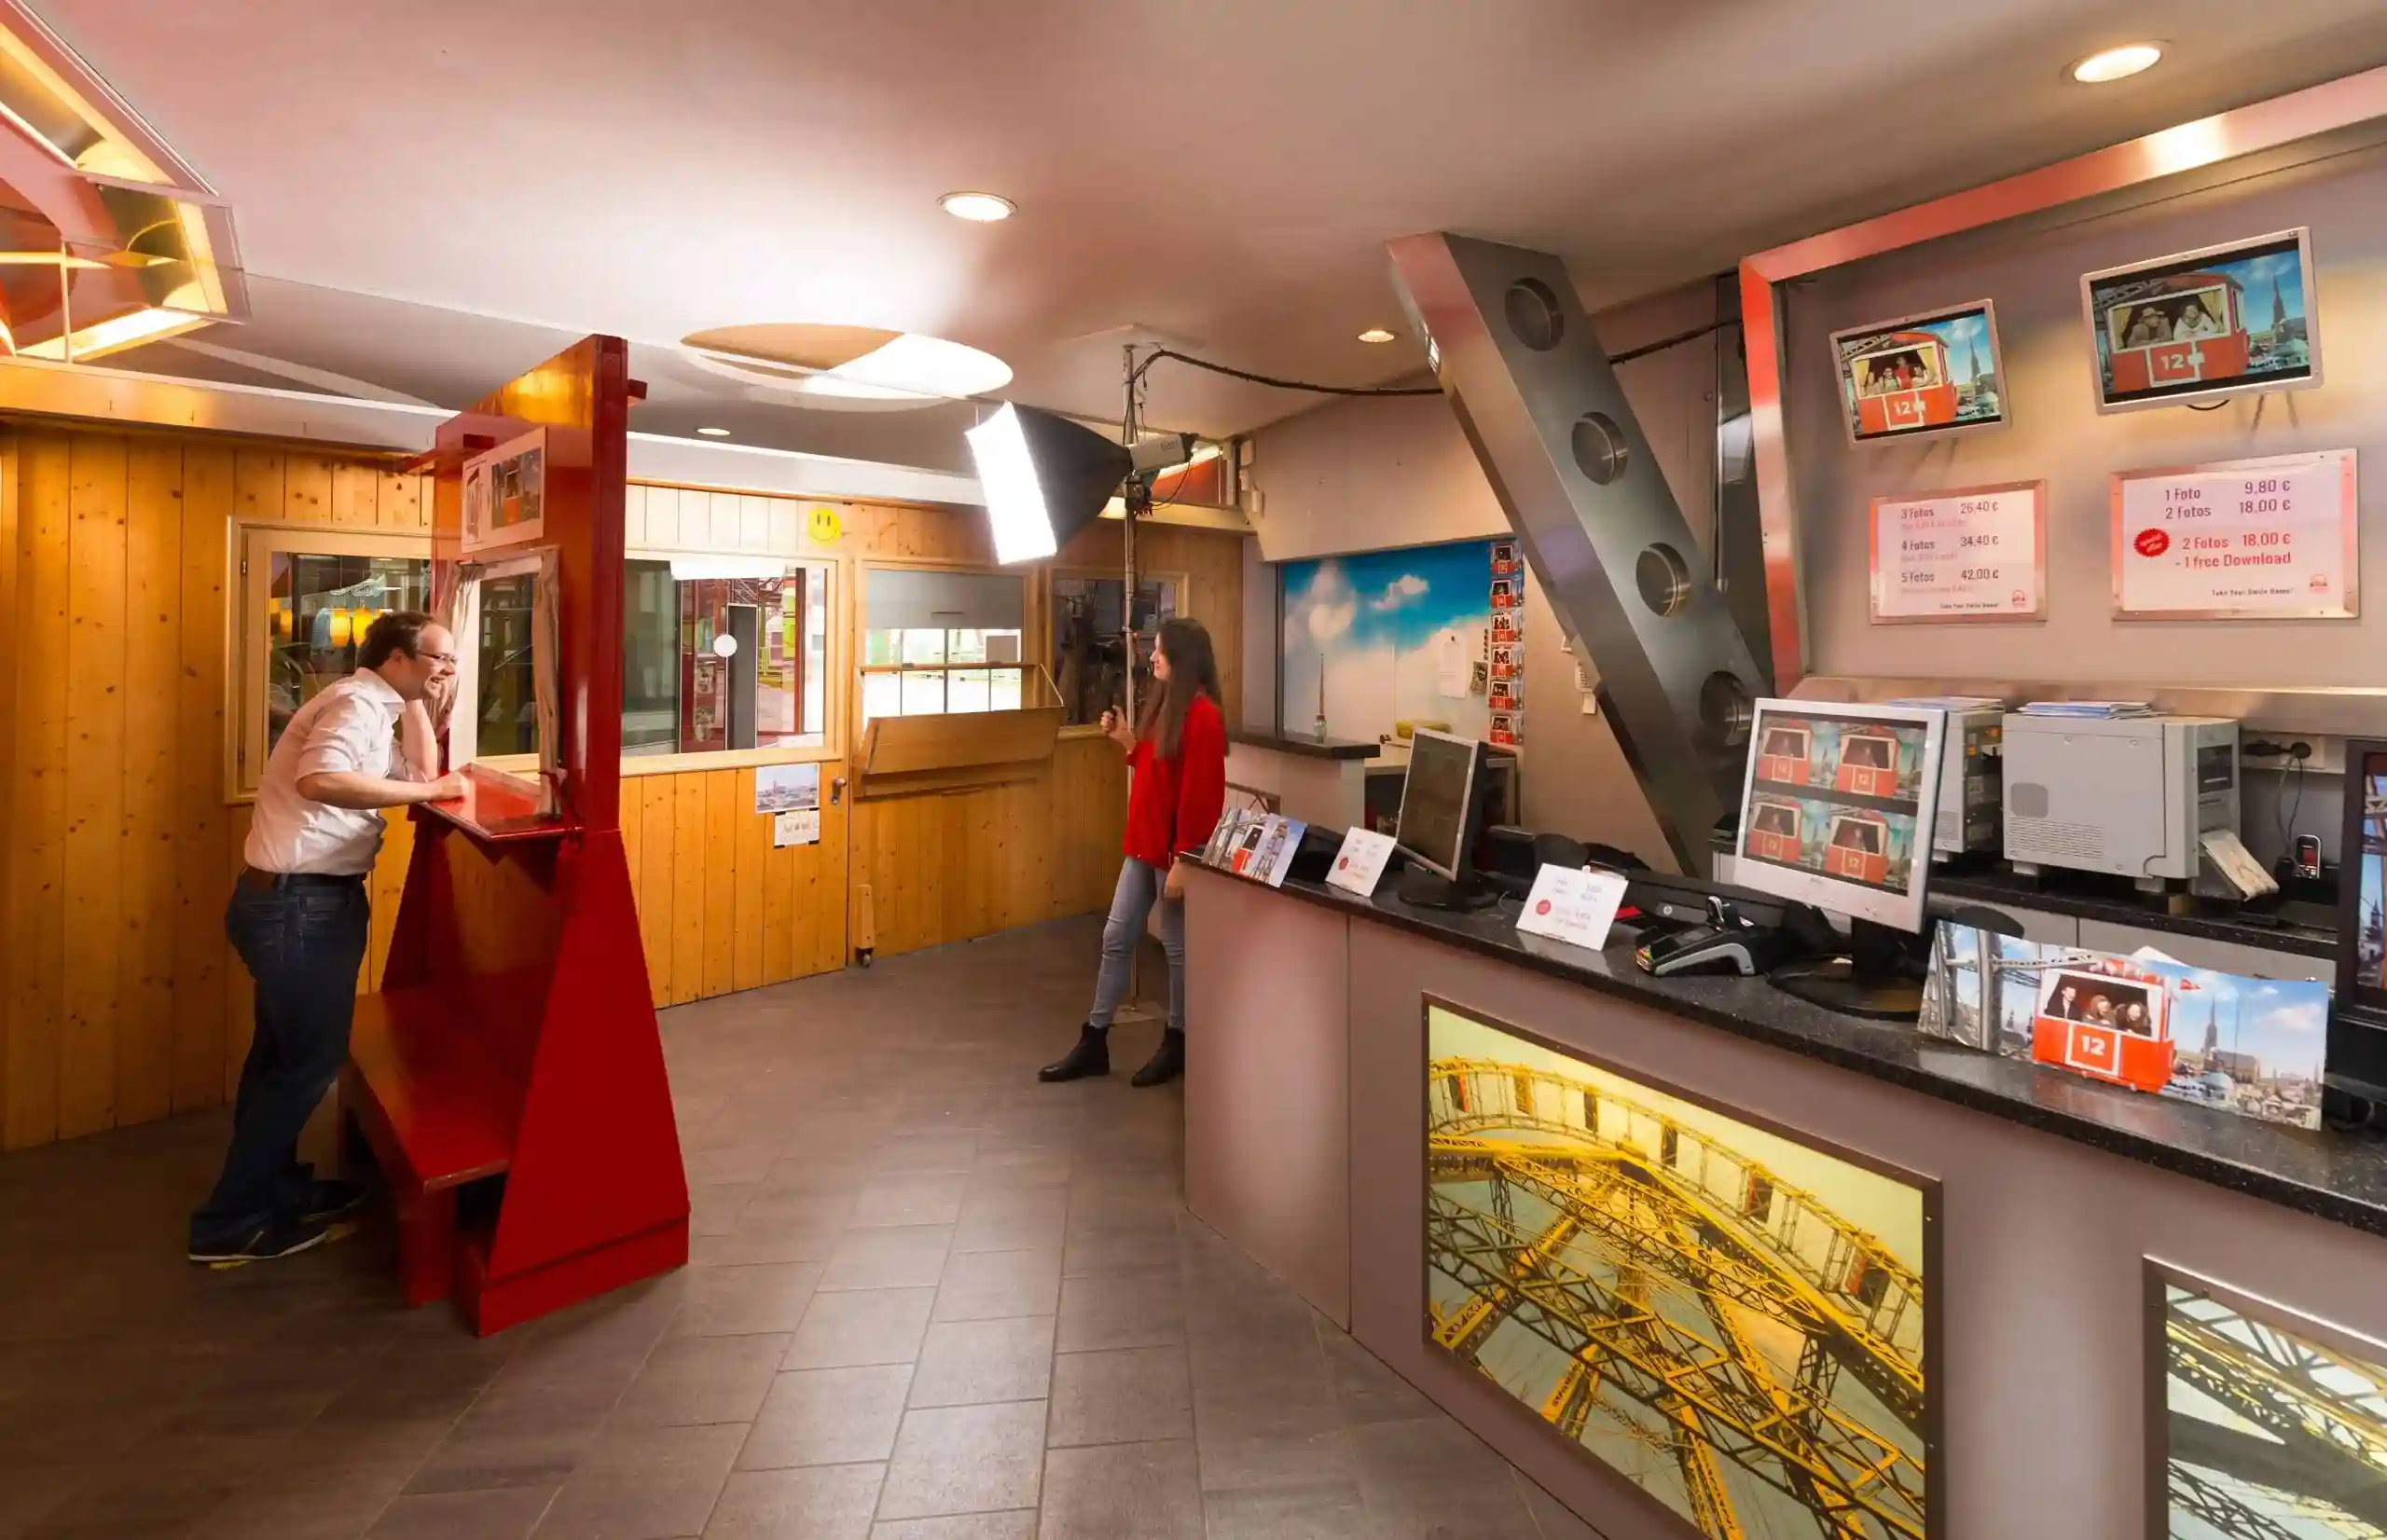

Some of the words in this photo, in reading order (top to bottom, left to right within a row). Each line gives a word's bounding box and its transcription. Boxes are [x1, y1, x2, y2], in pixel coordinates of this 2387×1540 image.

[2160, 354, 2184, 370] 12
[1893, 400, 1911, 416] 12
[2165, 489, 2170, 502] 1
[2174, 488, 2201, 501] Foto
[1901, 508, 1908, 519] 3
[1910, 507, 1935, 519] Fotos
[2165, 507, 2173, 519] 2
[2177, 506, 2212, 519] Fotos
[1901, 540, 1908, 551] 4
[1910, 539, 1936, 551] Fotos
[2183, 538, 2190, 550] 2
[2195, 537, 2229, 549] Fotos
[2193, 555, 2220, 569] free
[2224, 551, 2292, 567] Download
[1901, 572, 1908, 584] 5
[1910, 571, 1936, 584] Fotos
[2081, 1035, 2105, 1056] 12
